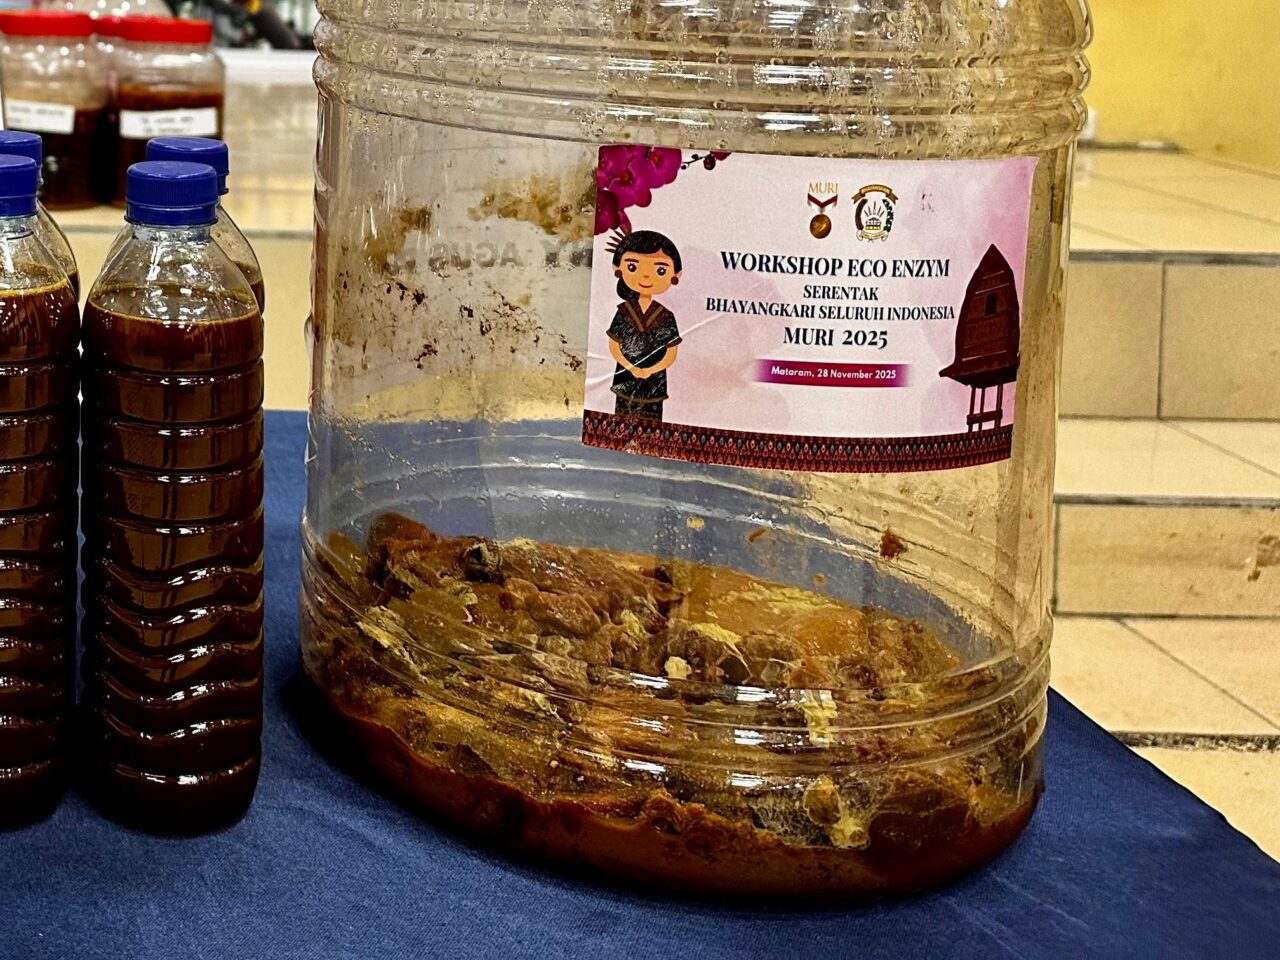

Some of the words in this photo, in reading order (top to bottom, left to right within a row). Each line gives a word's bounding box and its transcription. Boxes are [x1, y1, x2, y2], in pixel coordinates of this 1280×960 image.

[808, 182, 838, 194] MURI
[720, 250, 843, 277] WORKSHOP
[847, 258, 887, 278] ECO
[891, 258, 950, 278] ENZYM
[803, 284, 879, 301] SERENTAK
[706, 297, 815, 319] BHAYANGKARI
[818, 305, 884, 320] SELURUH
[887, 305, 955, 321] INDONESIA
[783, 326, 834, 346] MURI
[842, 329, 888, 349] 2025
[771, 365, 815, 378] Mataram,
[817, 368, 828, 378] 28
[830, 368, 873, 380] November
[875, 369, 897, 379] 2025
